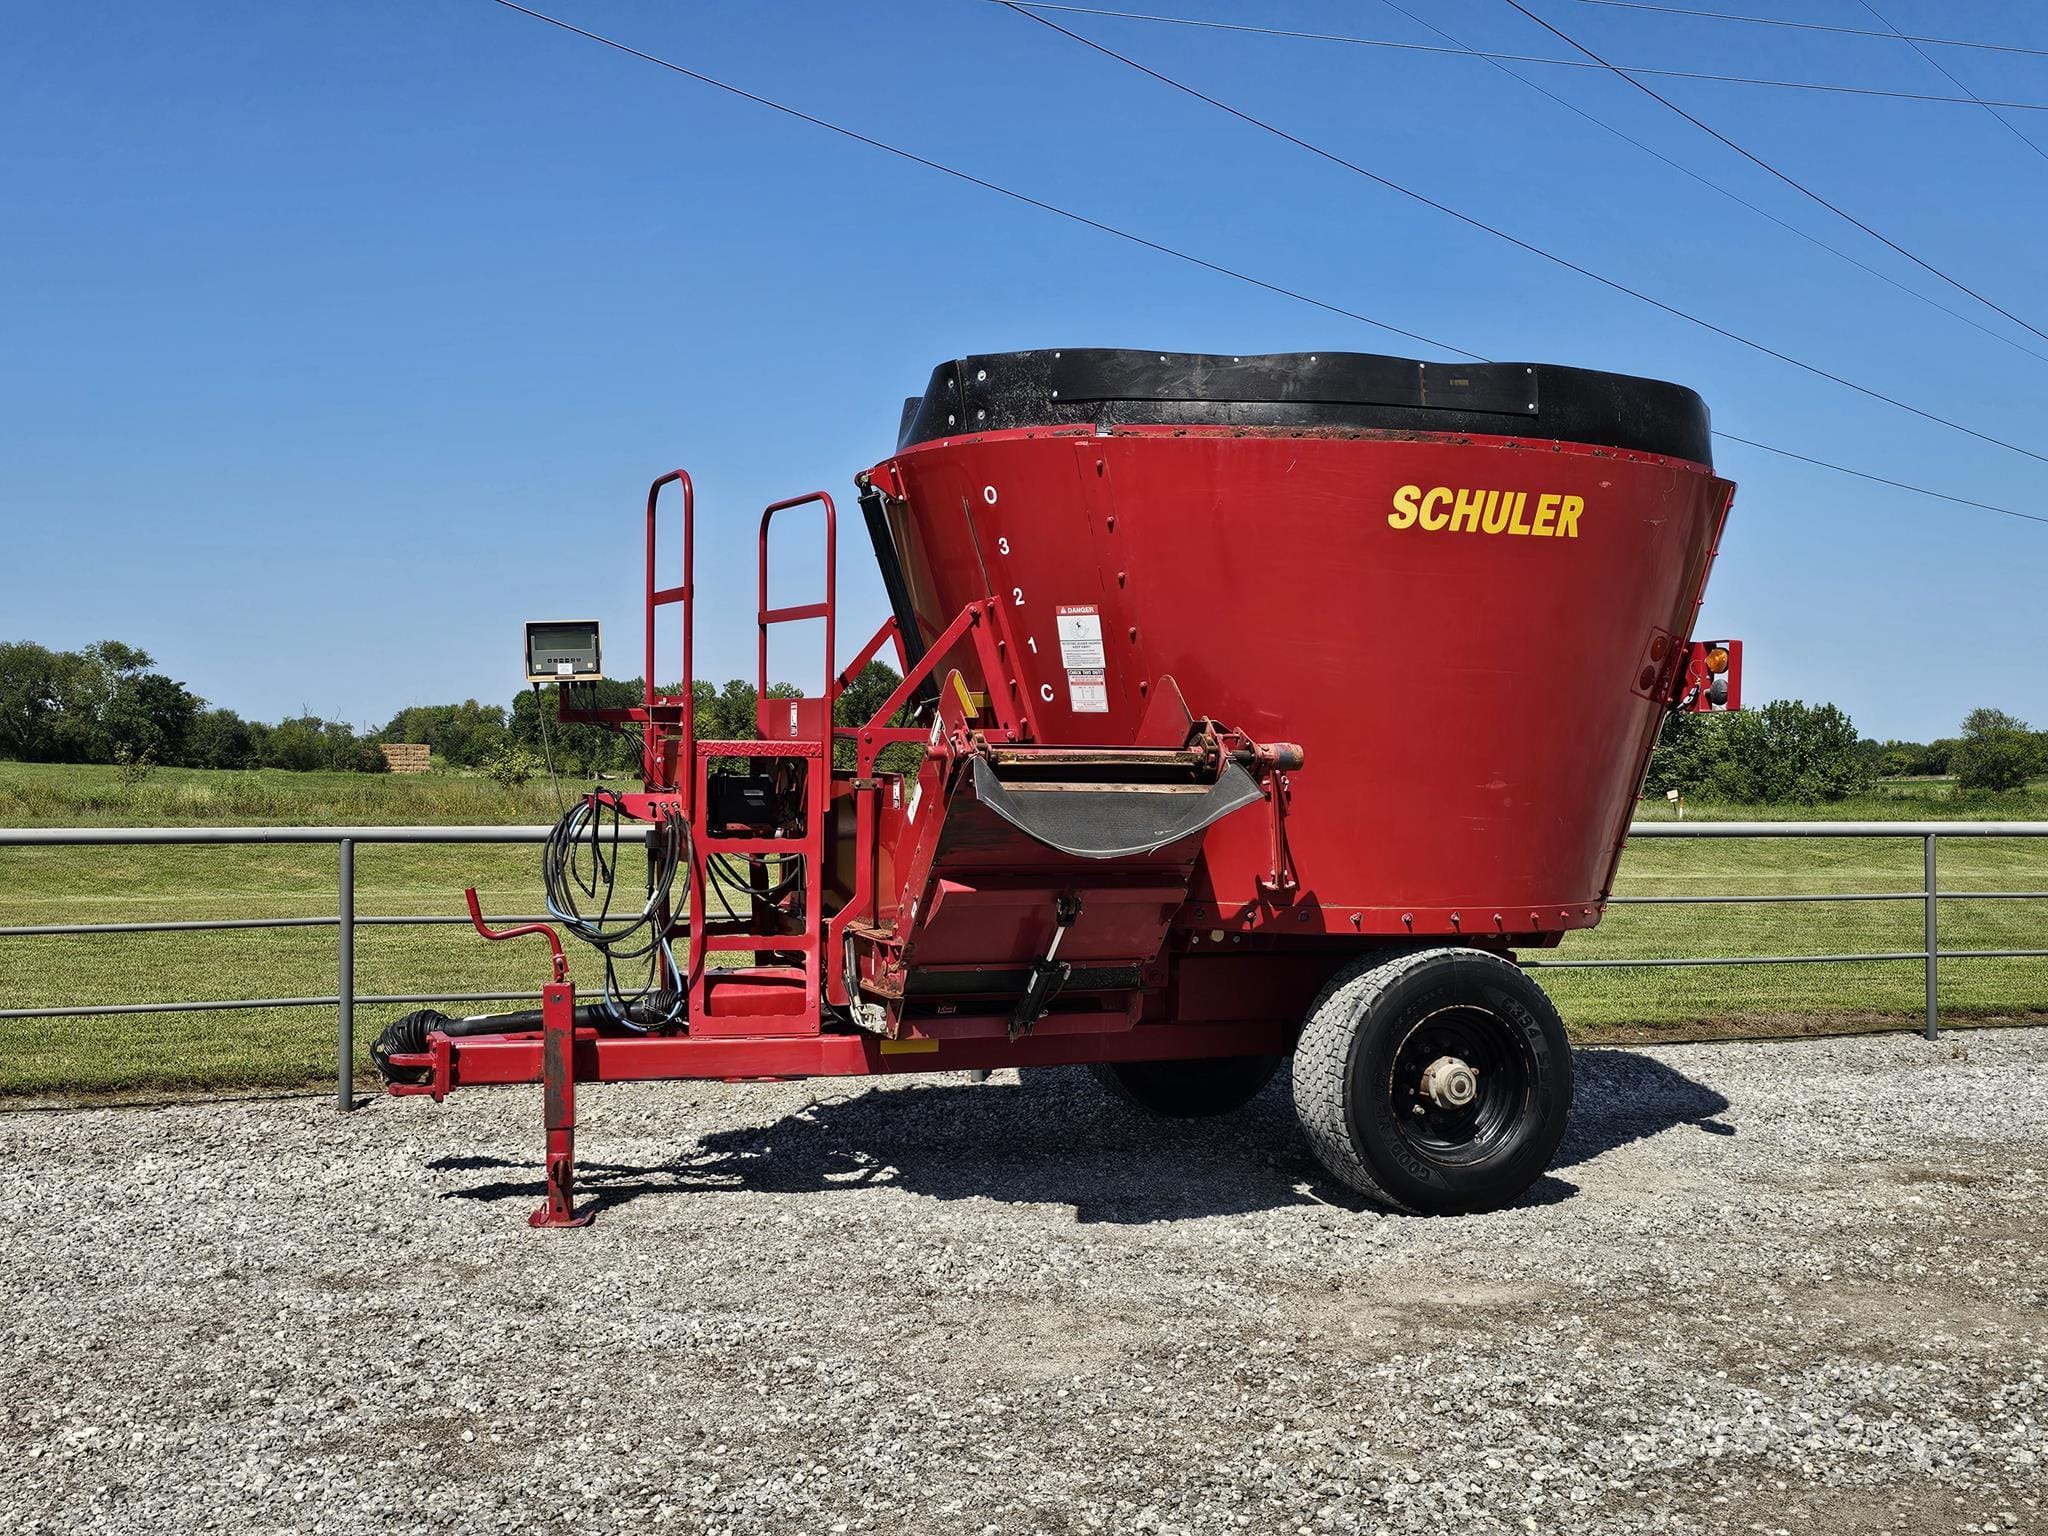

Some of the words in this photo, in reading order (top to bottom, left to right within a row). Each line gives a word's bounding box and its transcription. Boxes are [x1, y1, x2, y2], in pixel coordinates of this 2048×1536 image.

[1387, 484, 1585, 538] SCHULER
[998, 537, 1010, 555] 3
[1012, 587, 1025, 606] 2
[1067, 606, 1095, 614] DANGER
[1027, 636, 1038, 654] 1
[1040, 683, 1054, 702] C
[1502, 997, 1542, 1040] G394
